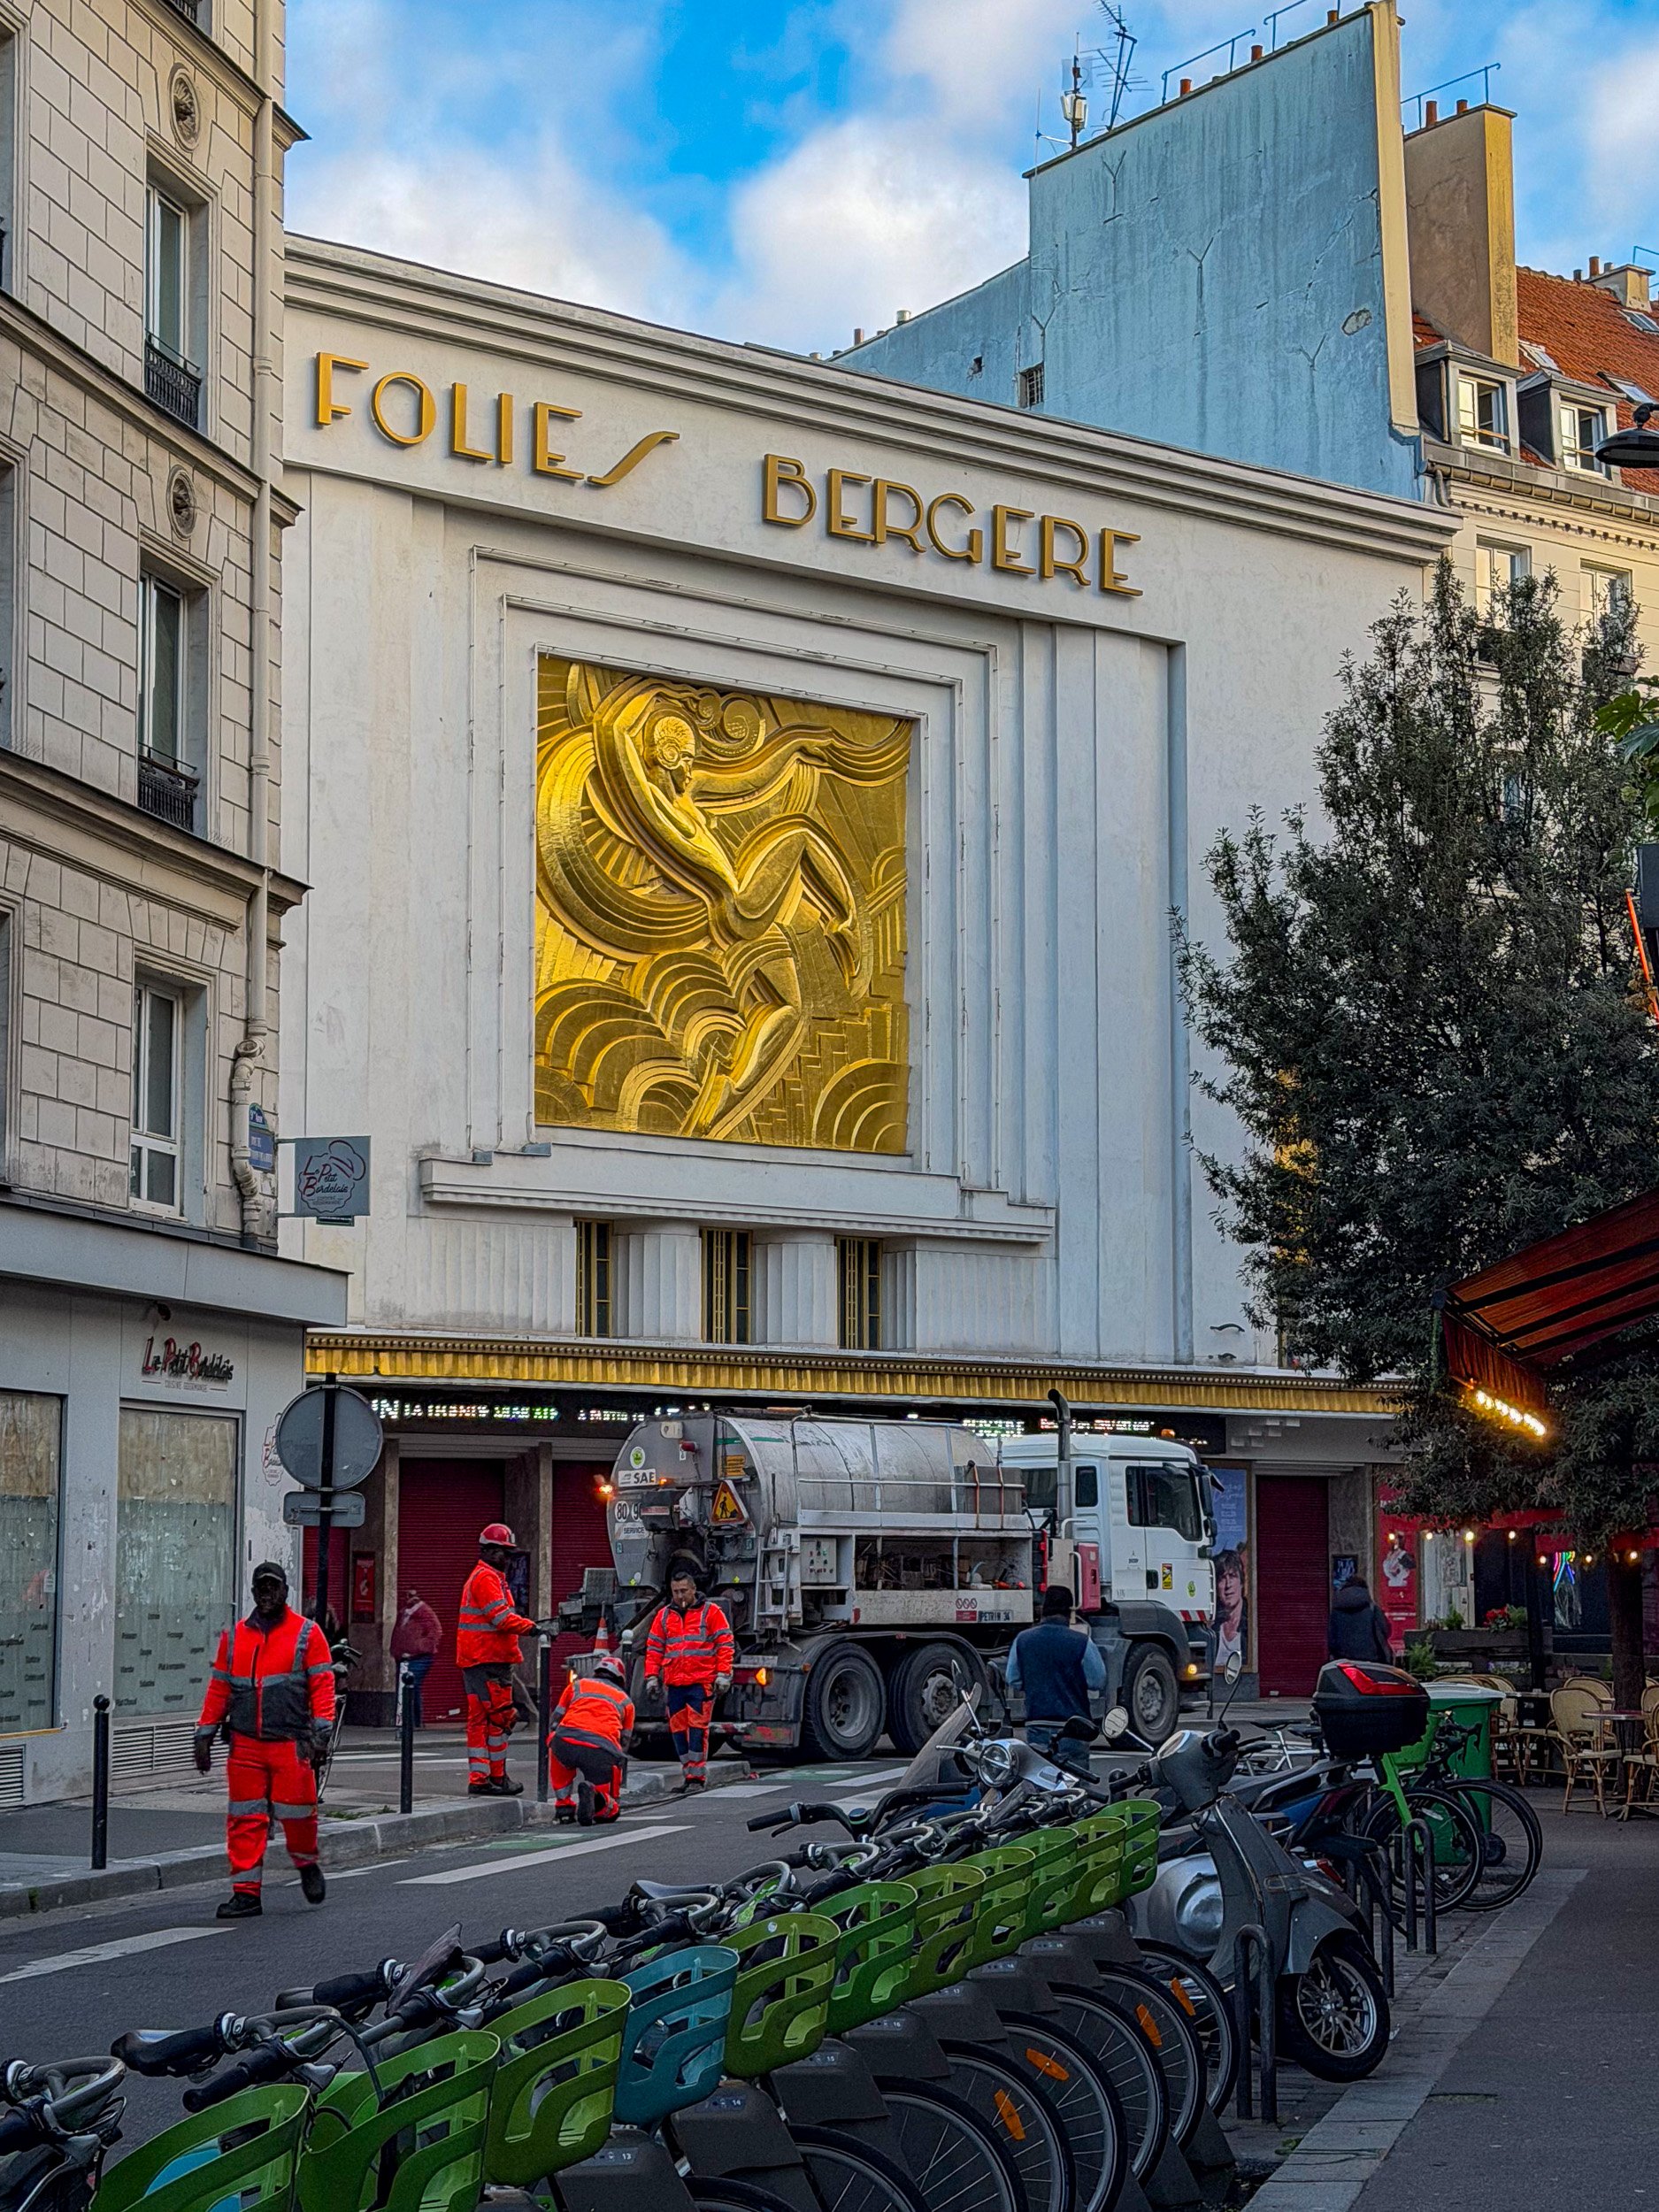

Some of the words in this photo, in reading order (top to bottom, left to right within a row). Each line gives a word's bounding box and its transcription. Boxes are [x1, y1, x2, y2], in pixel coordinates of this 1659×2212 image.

[316, 351, 680, 486] FOLIES
[763, 453, 1144, 596] BERGERE
[303, 1156, 319, 1176] Le
[318, 1164, 338, 1183] Petit
[303, 1176, 349, 1197] Bordelais
[634, 1471, 655, 1484] SAE
[617, 1503, 627, 1520] 80
